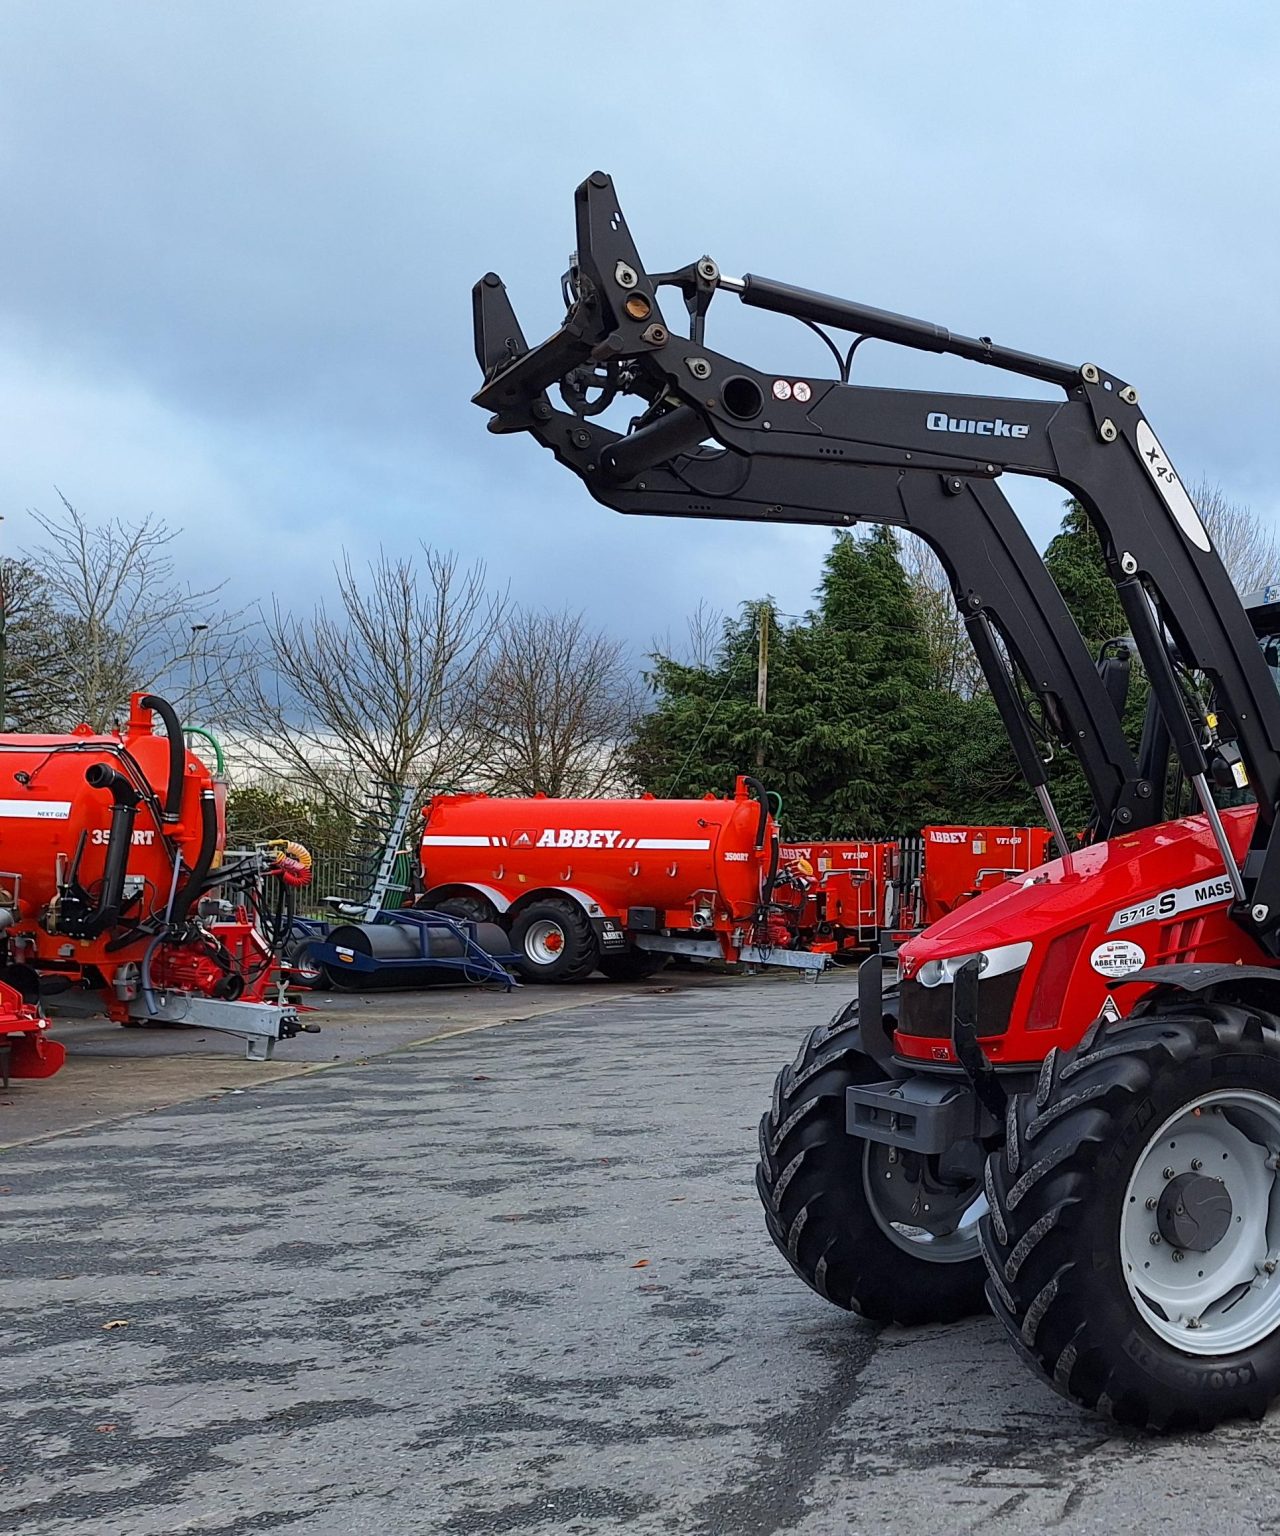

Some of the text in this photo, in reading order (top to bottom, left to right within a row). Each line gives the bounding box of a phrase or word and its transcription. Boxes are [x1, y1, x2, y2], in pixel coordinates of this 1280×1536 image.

[926, 412, 1029, 438] Quicke
[92, 829, 154, 845] 35RT
[536, 829, 621, 848] ABBEY
[930, 831, 967, 843] ABBEY
[724, 852, 749, 862] 3500RT
[1119, 905, 1155, 924] 5712
[1160, 893, 1176, 914] S
